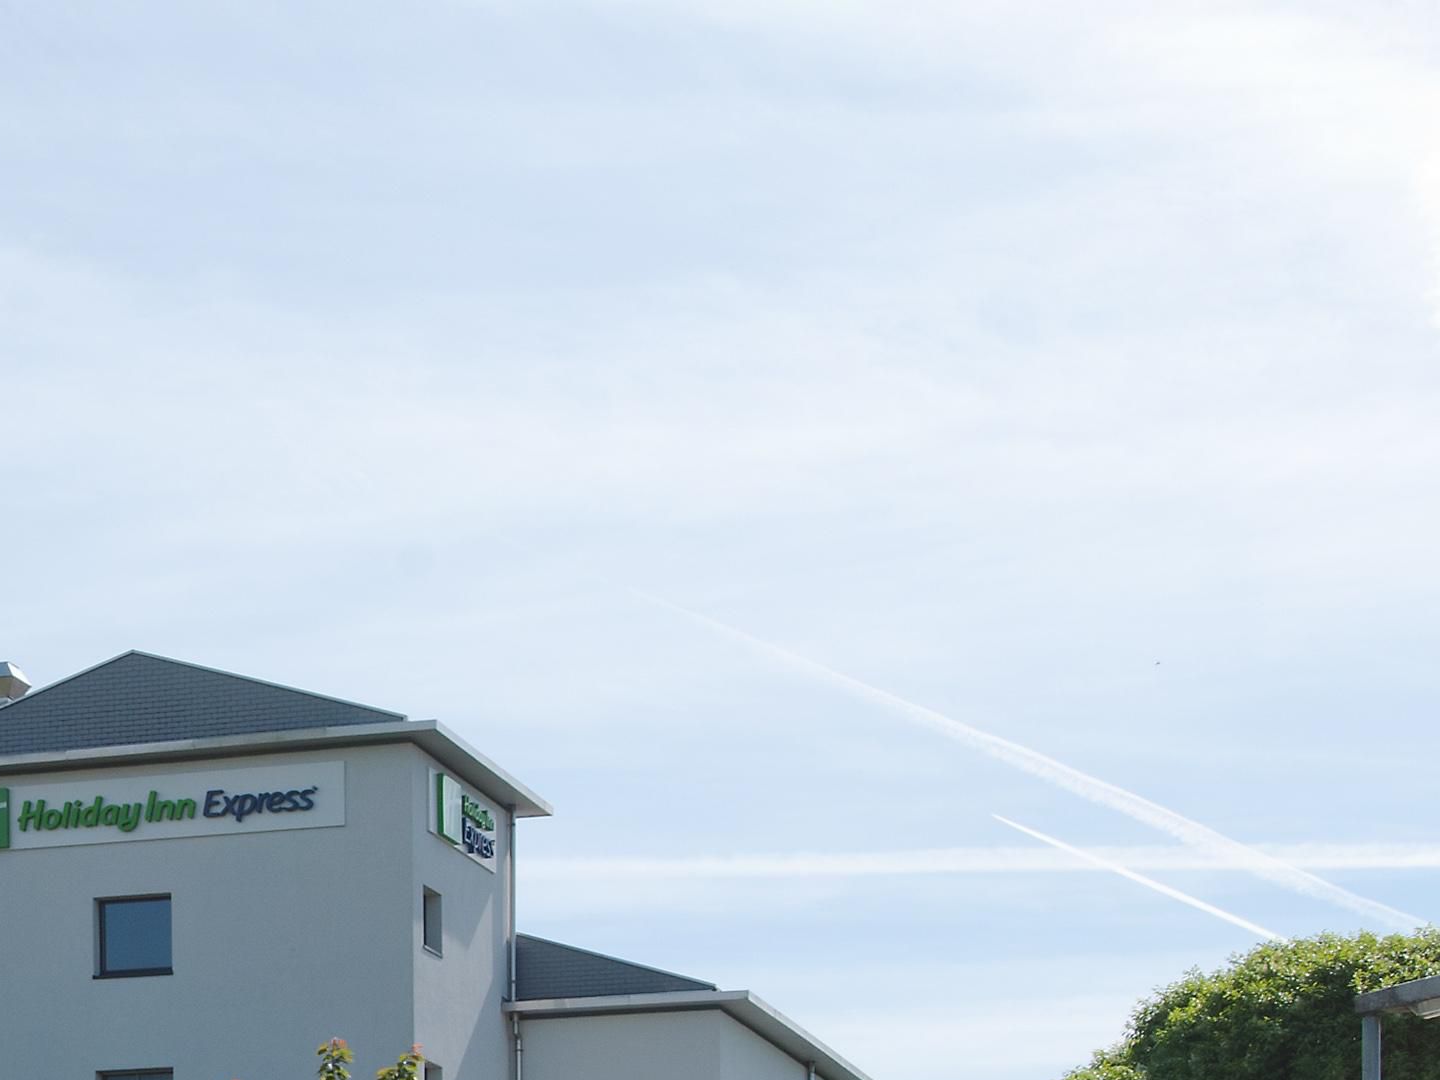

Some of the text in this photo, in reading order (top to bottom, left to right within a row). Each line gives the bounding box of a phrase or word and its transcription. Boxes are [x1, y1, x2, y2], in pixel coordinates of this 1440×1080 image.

[17, 796, 141, 832] Holiday
[145, 790, 196, 822] Inn
[203, 788, 316, 822] Express
